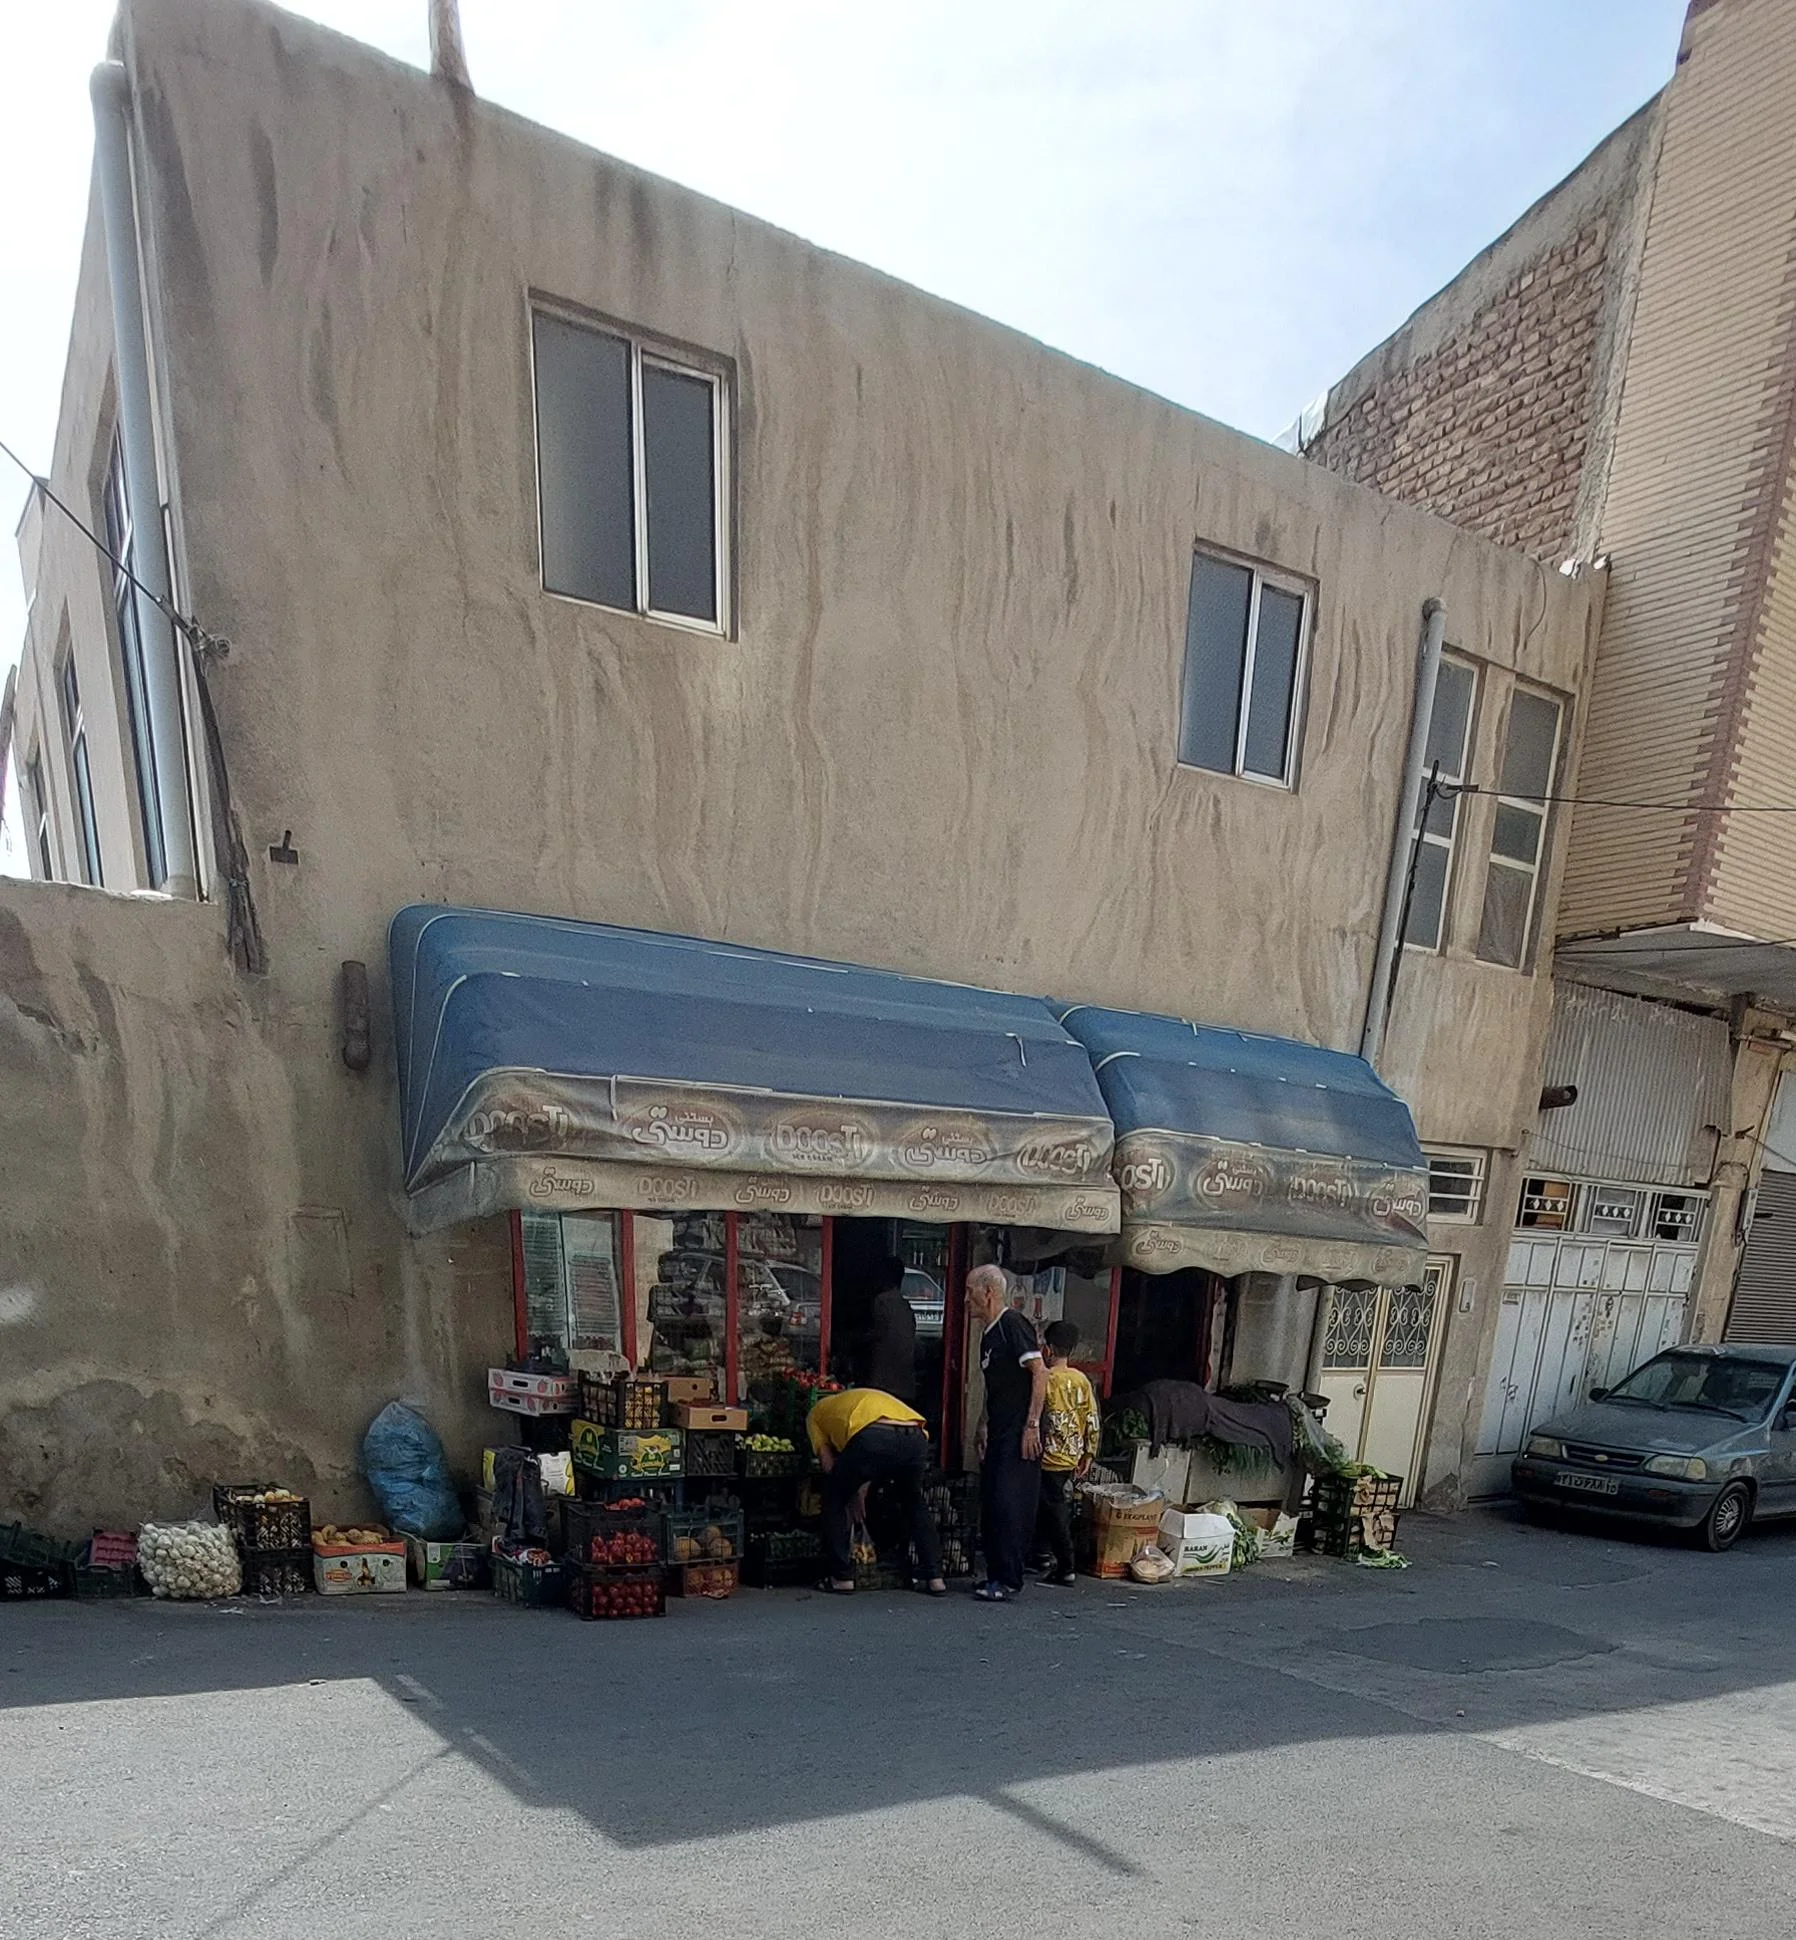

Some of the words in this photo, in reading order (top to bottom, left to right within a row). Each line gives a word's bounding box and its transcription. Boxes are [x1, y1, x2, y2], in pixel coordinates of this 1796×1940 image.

[631, 1105, 728, 1149] دوستی
[904, 1126, 987, 1167] دوستی
[530, 1166, 595, 1197] دوستی
[735, 1175, 792, 1203] دوستی
[1202, 1160, 1263, 1197] دوستی
[909, 1184, 960, 1212] دوستی
[1065, 1195, 1110, 1221] دوستی
[1136, 1229, 1181, 1255] دوستی
